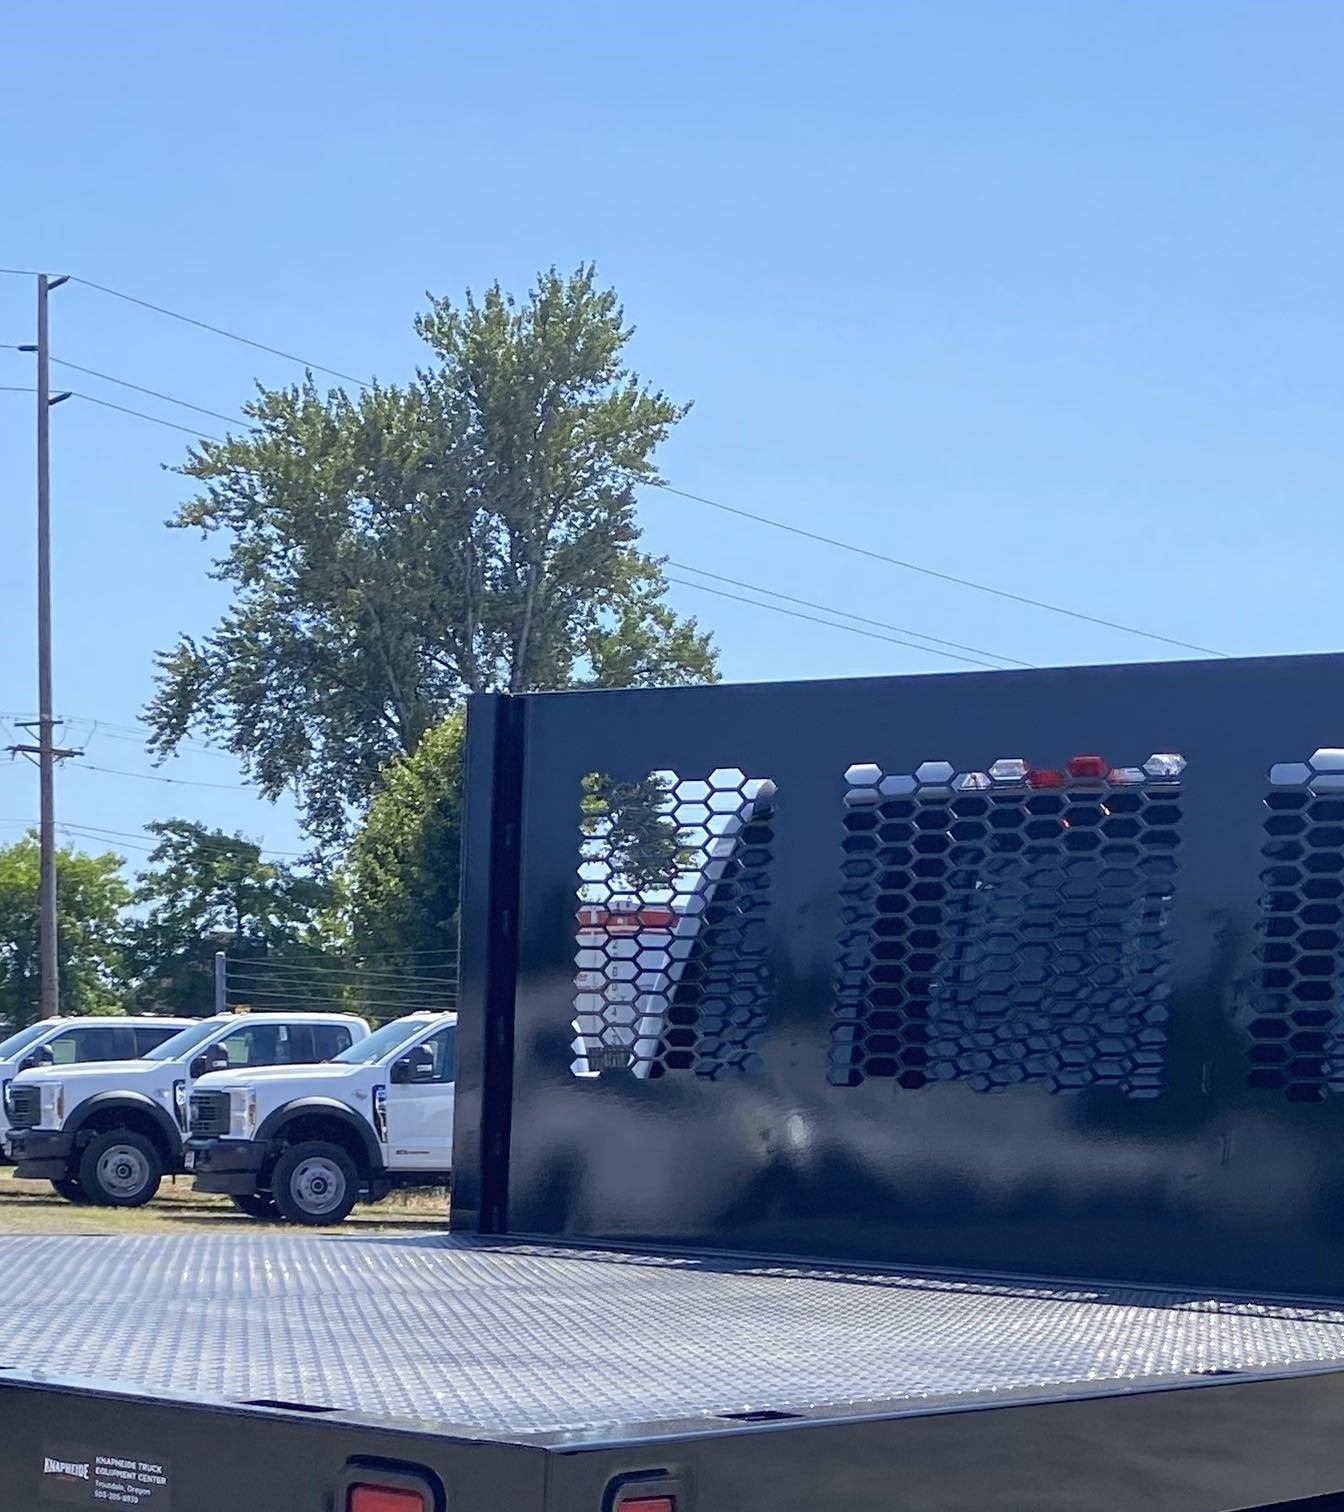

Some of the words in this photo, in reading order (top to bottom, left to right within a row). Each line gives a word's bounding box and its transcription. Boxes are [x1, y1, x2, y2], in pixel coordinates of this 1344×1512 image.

[44, 1457, 90, 1480] KNAPHEIDE
[95, 1456, 137, 1470] KNAPHEIDE
[138, 1462, 162, 1474] TRUCK
[95, 1466, 137, 1480] EQUIPMENT
[138, 1473, 167, 1485] CENTER
